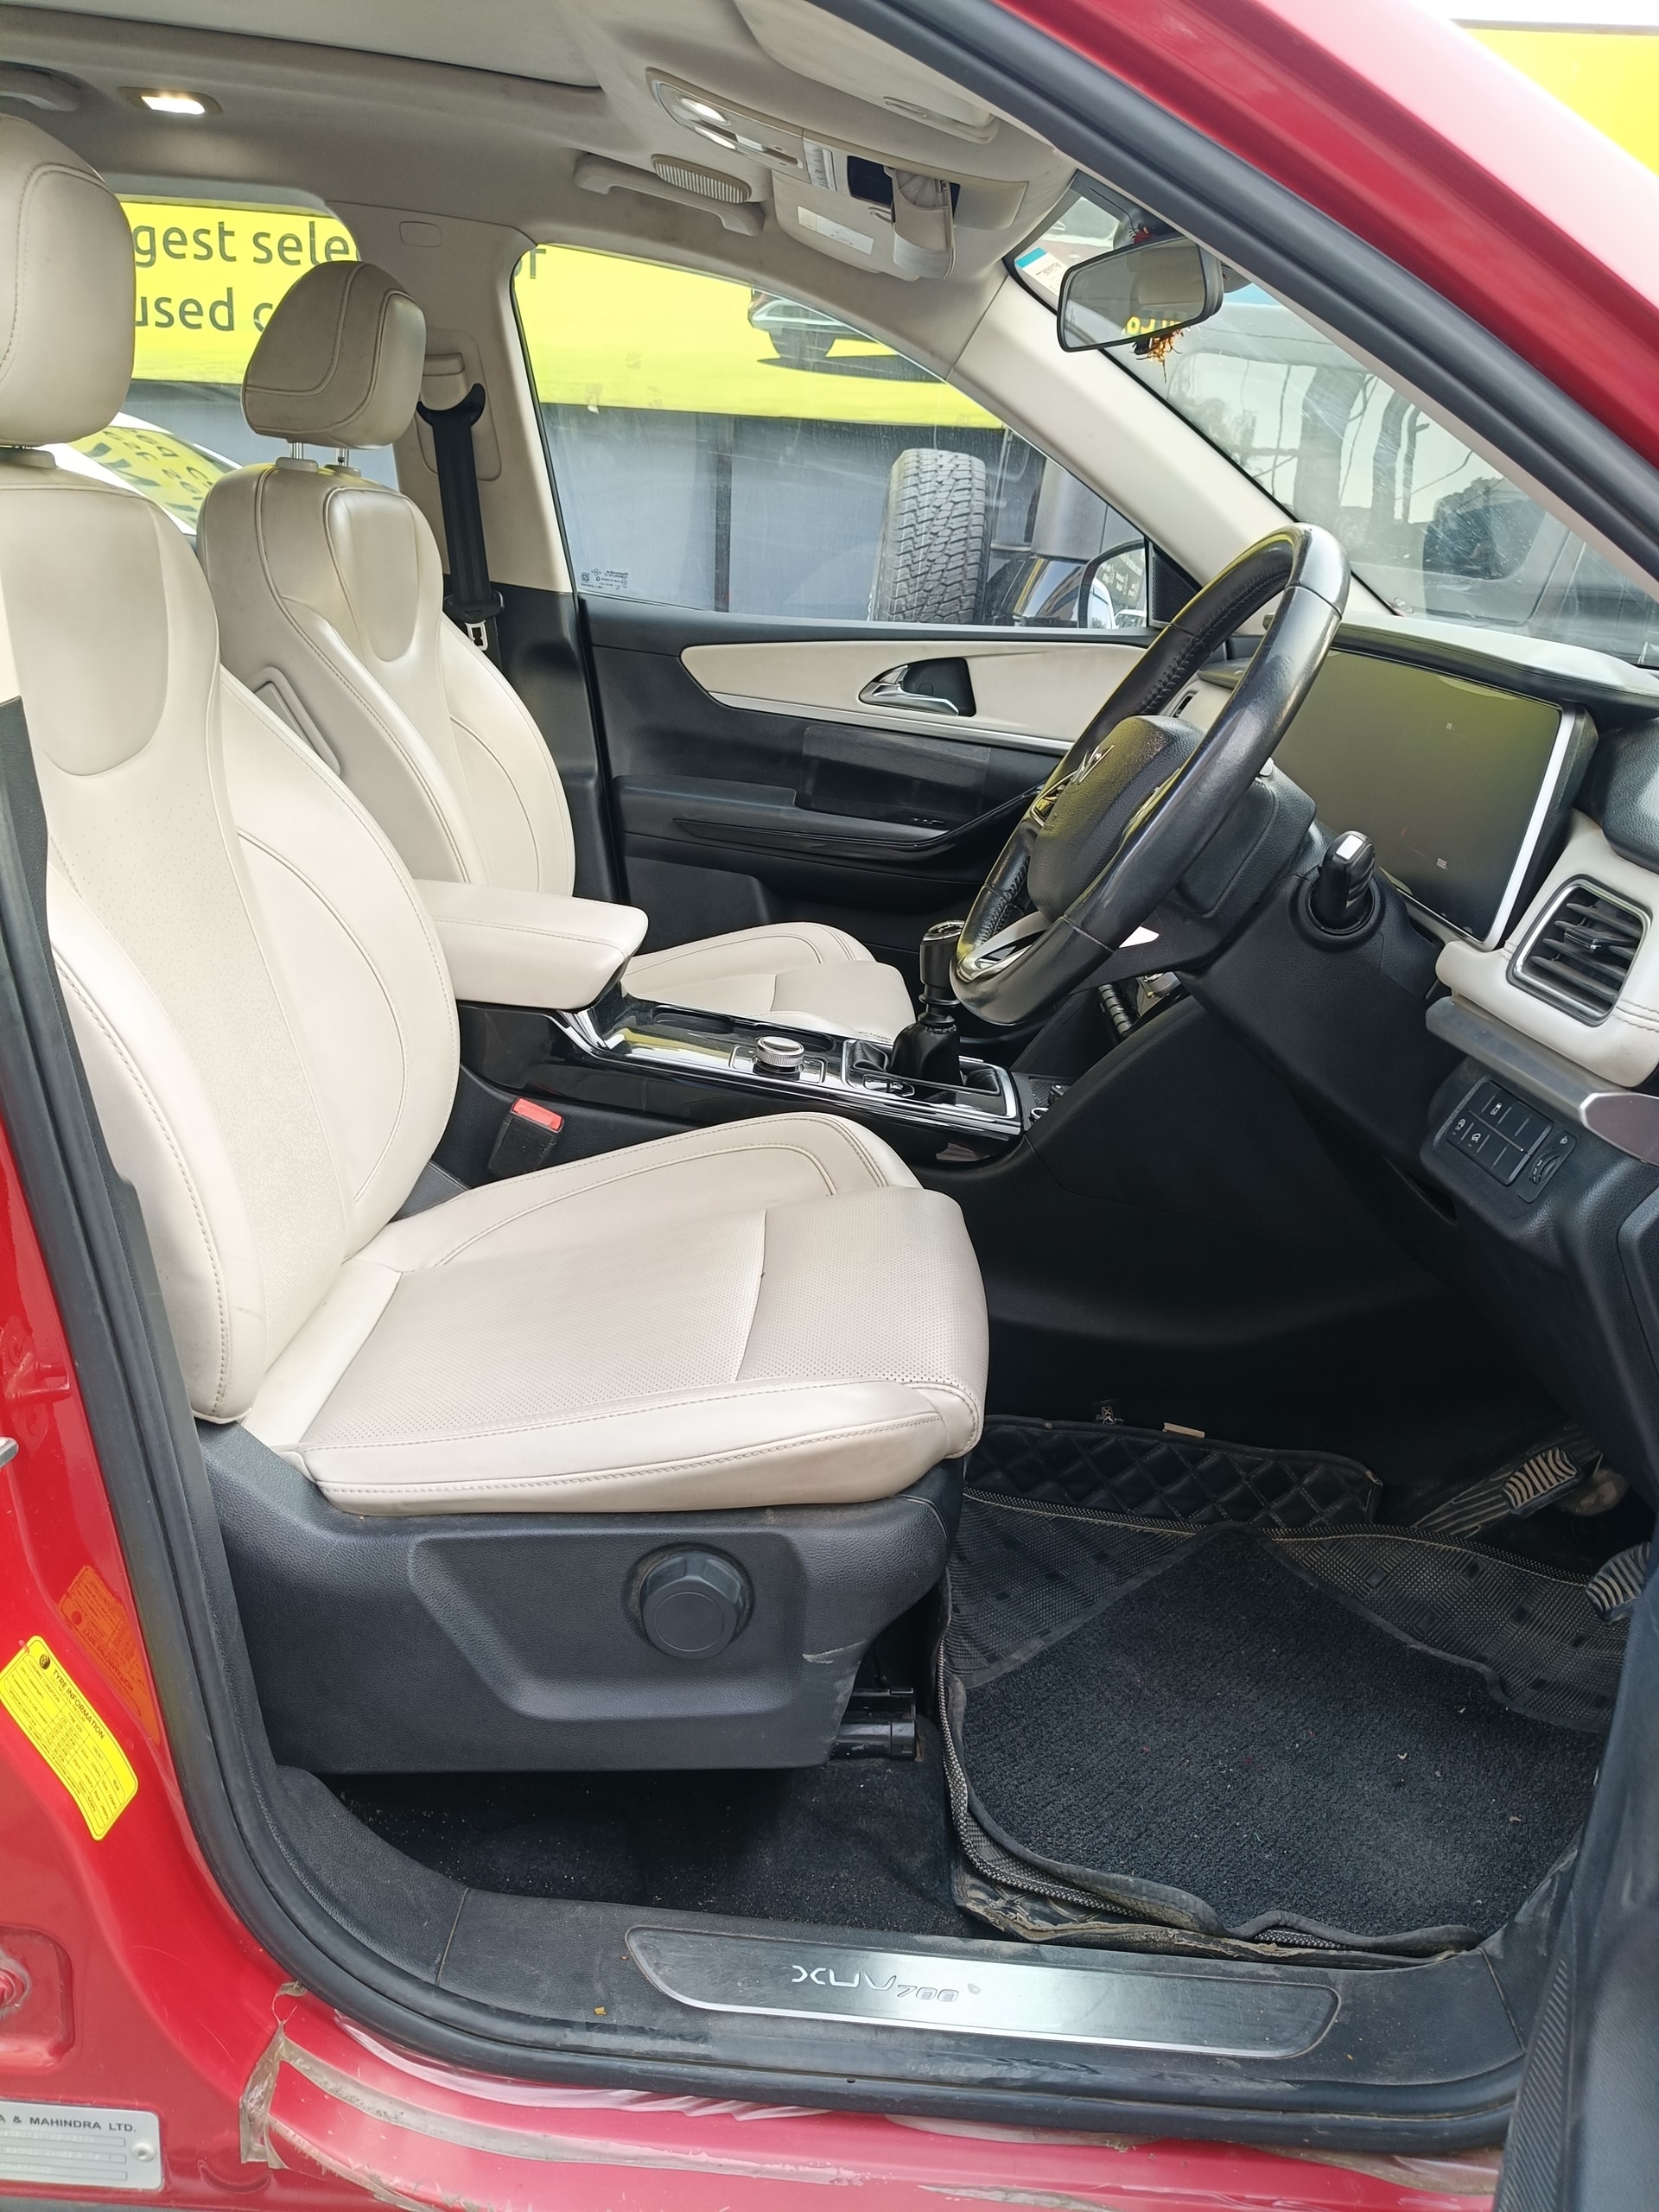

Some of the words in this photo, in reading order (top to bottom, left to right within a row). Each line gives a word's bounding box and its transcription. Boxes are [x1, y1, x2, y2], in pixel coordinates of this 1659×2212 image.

[252, 220, 361, 265] sele
[52, 1669, 67, 1689] TYRE
[67, 1688, 105, 1739] INFORMATION
[13, 2115, 22, 2124] &
[29, 2116, 102, 2130] MAHINDRA
[109, 2123, 137, 2133] LTD.
